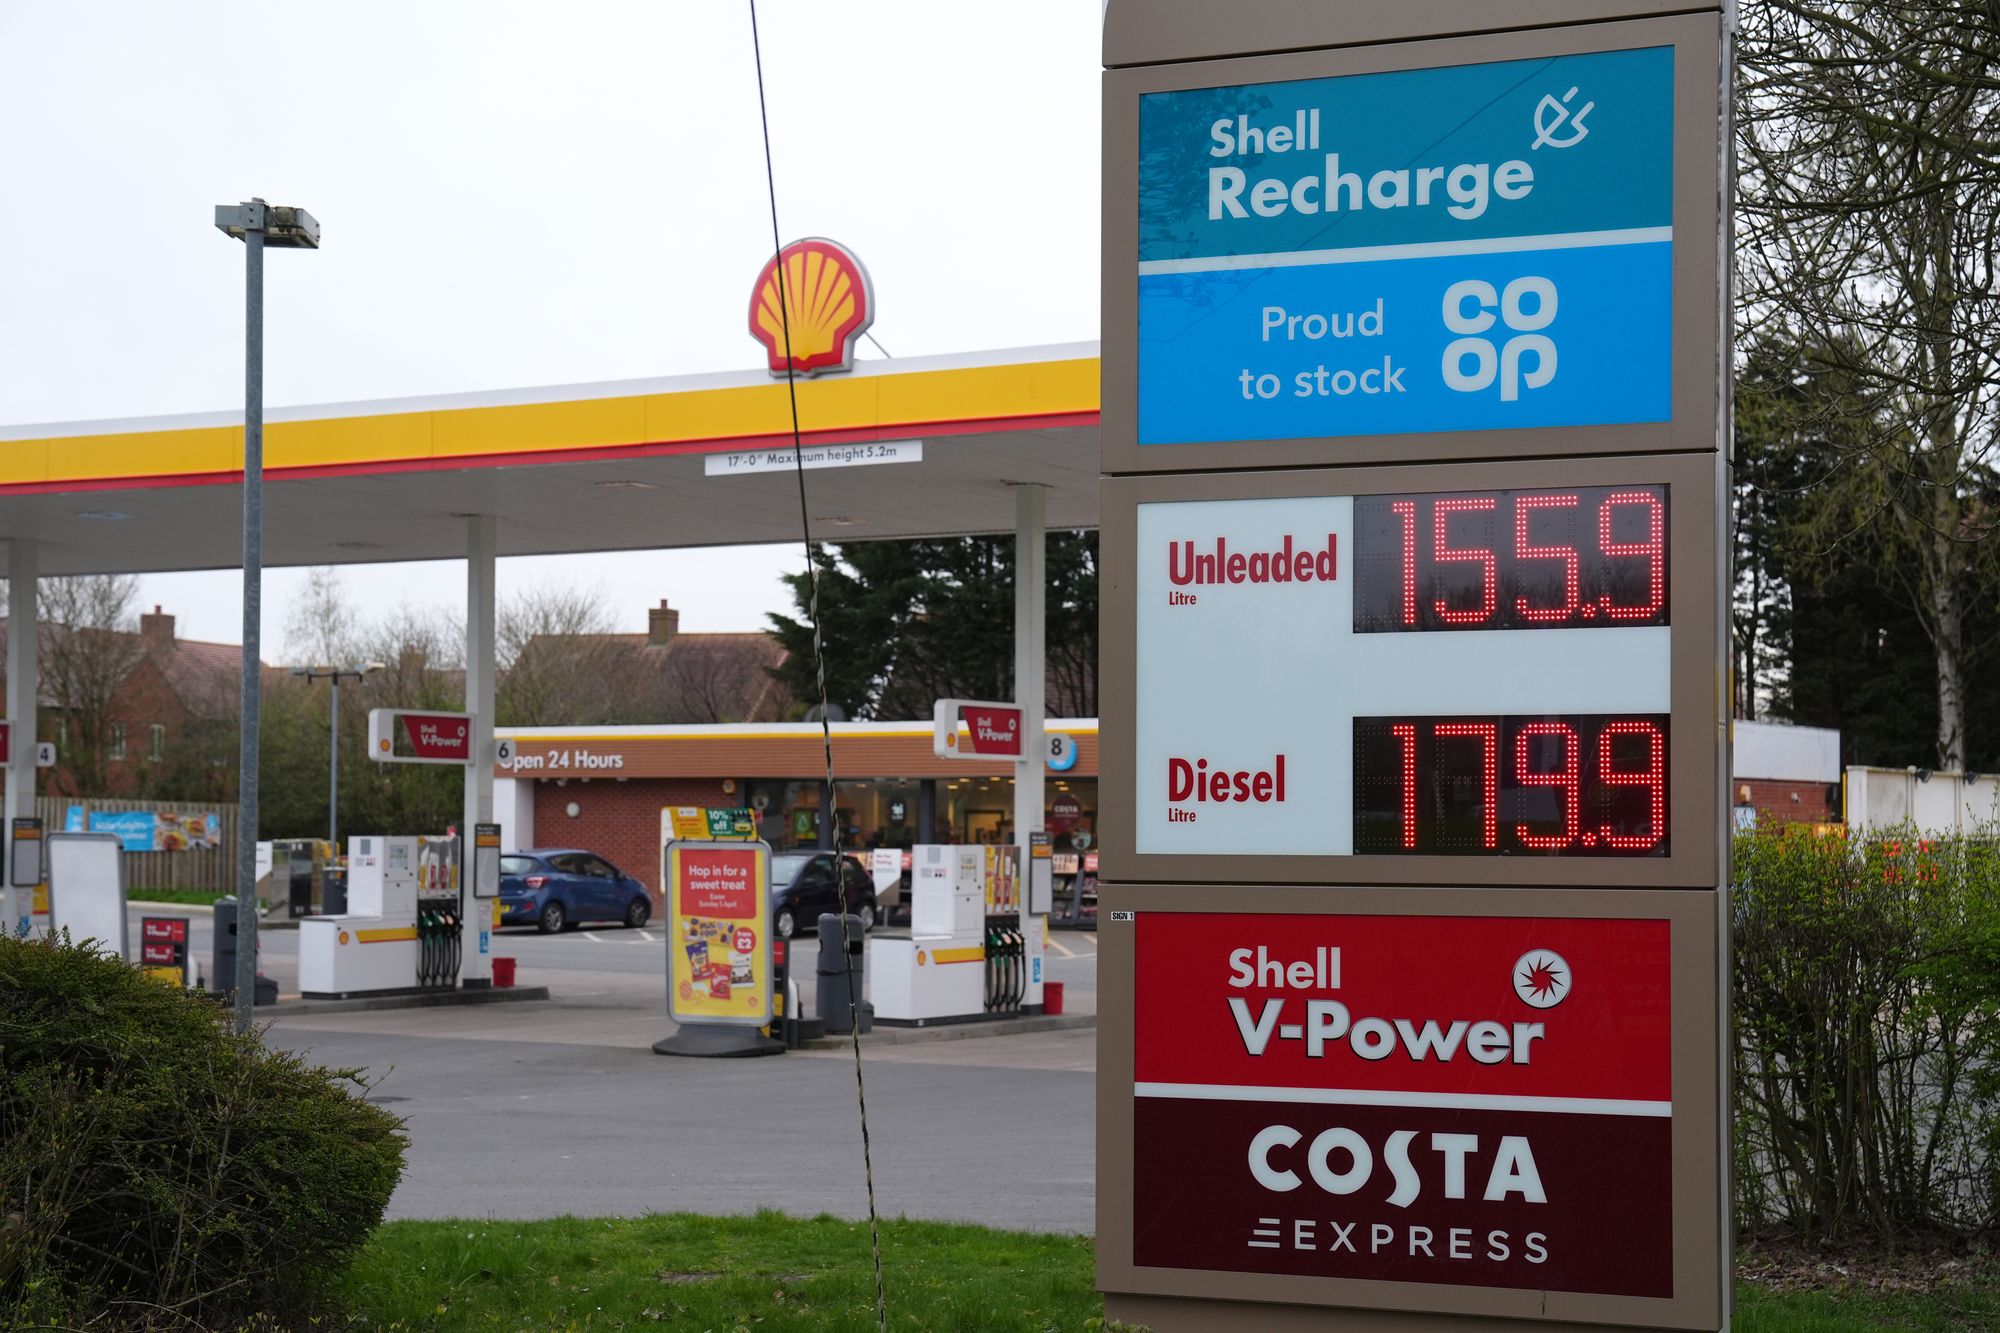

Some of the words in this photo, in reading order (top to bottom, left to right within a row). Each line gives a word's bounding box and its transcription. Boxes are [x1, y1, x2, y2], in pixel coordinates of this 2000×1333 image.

[1208, 108, 1321, 158] Shell
[1208, 153, 1535, 220] Recharge
[1261, 298, 1384, 342] Proud
[1238, 368, 1281, 400] to
[1294, 355, 1407, 398] stock
[766, 452, 824, 465] Maximum
[827, 447, 864, 462] height
[866, 446, 897, 457] 5.2m
[1168, 533, 1338, 585] Unleaded
[1393, 491, 1664, 625] 155.9
[1168, 591, 1197, 606] Litre
[420, 734, 462, 748] V-Power
[498, 742, 509, 758] 6
[977, 728, 1013, 742] V-Power
[1050, 737, 1063, 756] 8
[40, 747, 49, 762] 4
[548, 751, 570, 768] 24
[575, 750, 624, 768] Hours
[1168, 754, 1286, 802] Diesel
[1393, 721, 1665, 848] 179.9
[1168, 808, 1197, 823] Litre
[688, 865, 710, 878] Hop
[712, 865, 721, 875] in
[723, 864, 737, 876] for
[740, 868, 747, 876] a
[690, 881, 719, 890] sweet
[721, 880, 746, 890] treat
[1112, 912, 1127, 920] SIGN
[1227, 945, 1341, 989] Shell
[1227, 997, 1545, 1065] V-Power
[1247, 1124, 1548, 1209] COSTA
[1293, 1219, 1548, 1264] EXPRESS
